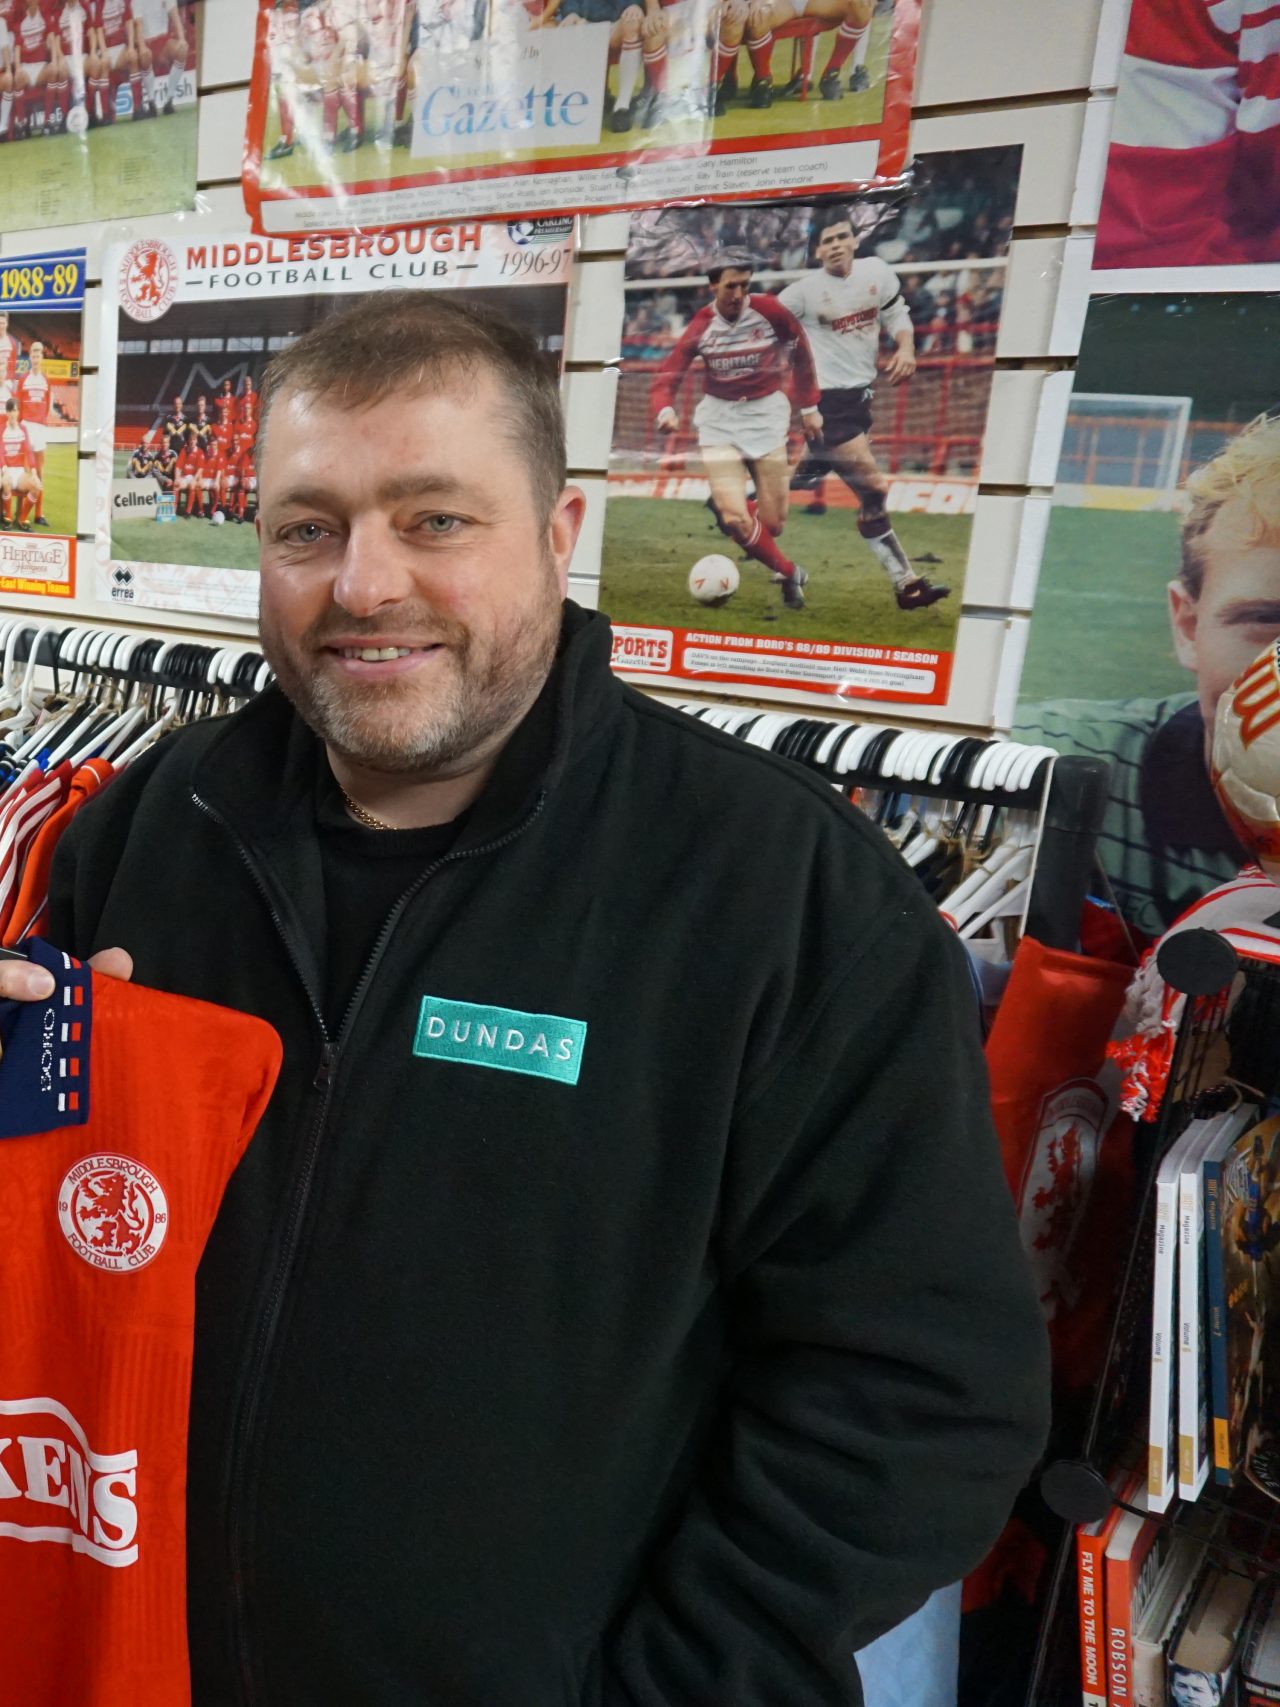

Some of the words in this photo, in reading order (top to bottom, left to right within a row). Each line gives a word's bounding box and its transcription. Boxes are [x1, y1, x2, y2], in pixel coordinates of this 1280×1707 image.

[422, 83, 589, 136] Gazette
[720, 155, 757, 166] Hamilton
[186, 224, 481, 270] MIDDLESBROUGH
[209, 266, 352, 289] FOOTBALL
[369, 260, 448, 279] CLUB
[499, 248, 572, 276] 1996-97
[114, 492, 157, 507] Cellnet
[2, 545, 62, 564] HERITAGE
[17, 579, 46, 594] Winning
[47, 581, 70, 595] Teams
[613, 635, 669, 659] PORTS
[686, 633, 721, 644] ACTION
[724, 636, 753, 647] FROM
[756, 639, 794, 651] BORO'S
[833, 645, 883, 660] DIVISION
[893, 651, 939, 665] SEASON
[41, 1008, 55, 1092] BORO
[427, 1016, 573, 1060] DUNDAS
[68, 1157, 158, 1194] MIDDLESBROUGH
[59, 1201, 68, 1212] 19
[155, 1213, 166, 1223] 86
[68, 1232, 122, 1270] FOOTBALL
[128, 1244, 156, 1266] CLUB
[1082, 1551, 1094, 1575] FLY
[1082, 1576, 1094, 1596] ME
[1083, 1599, 1094, 1616] TO
[1083, 1619, 1096, 1645] THE
[1086, 1646, 1098, 1686] MOON
[1111, 1628, 1127, 1698] ROBSON
